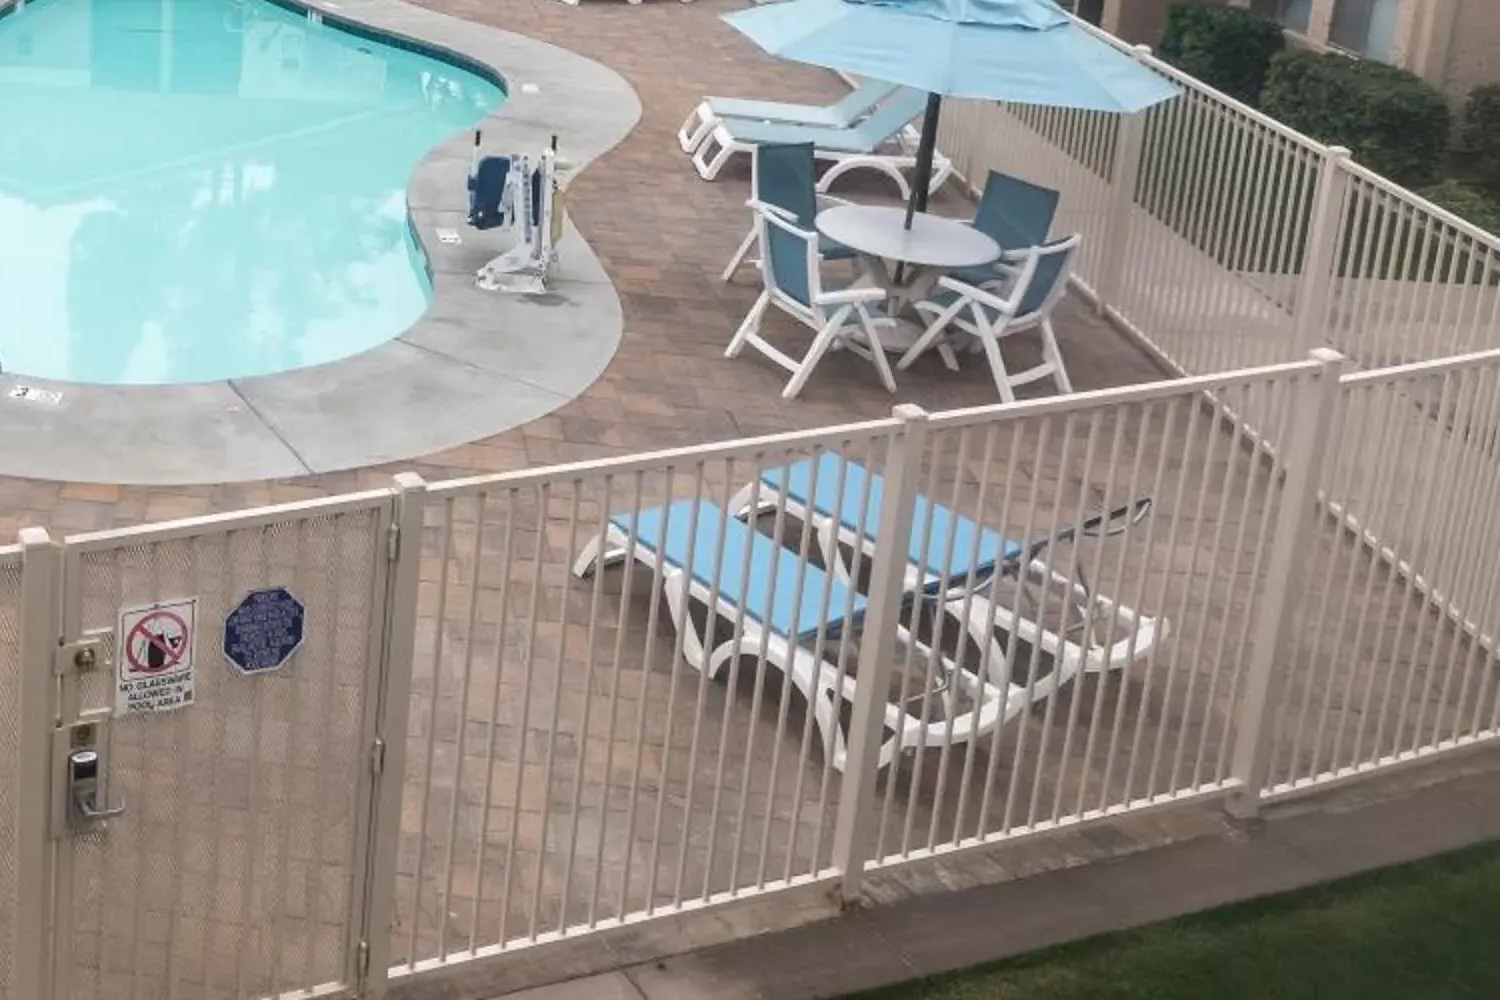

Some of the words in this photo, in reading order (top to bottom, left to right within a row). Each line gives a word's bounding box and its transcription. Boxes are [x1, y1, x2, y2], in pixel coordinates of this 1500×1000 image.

[120, 683, 134, 692] NO
[137, 671, 192, 688] GLASSWARE
[128, 686, 171, 700] ALLOWED
[157, 695, 181, 706] AREA
